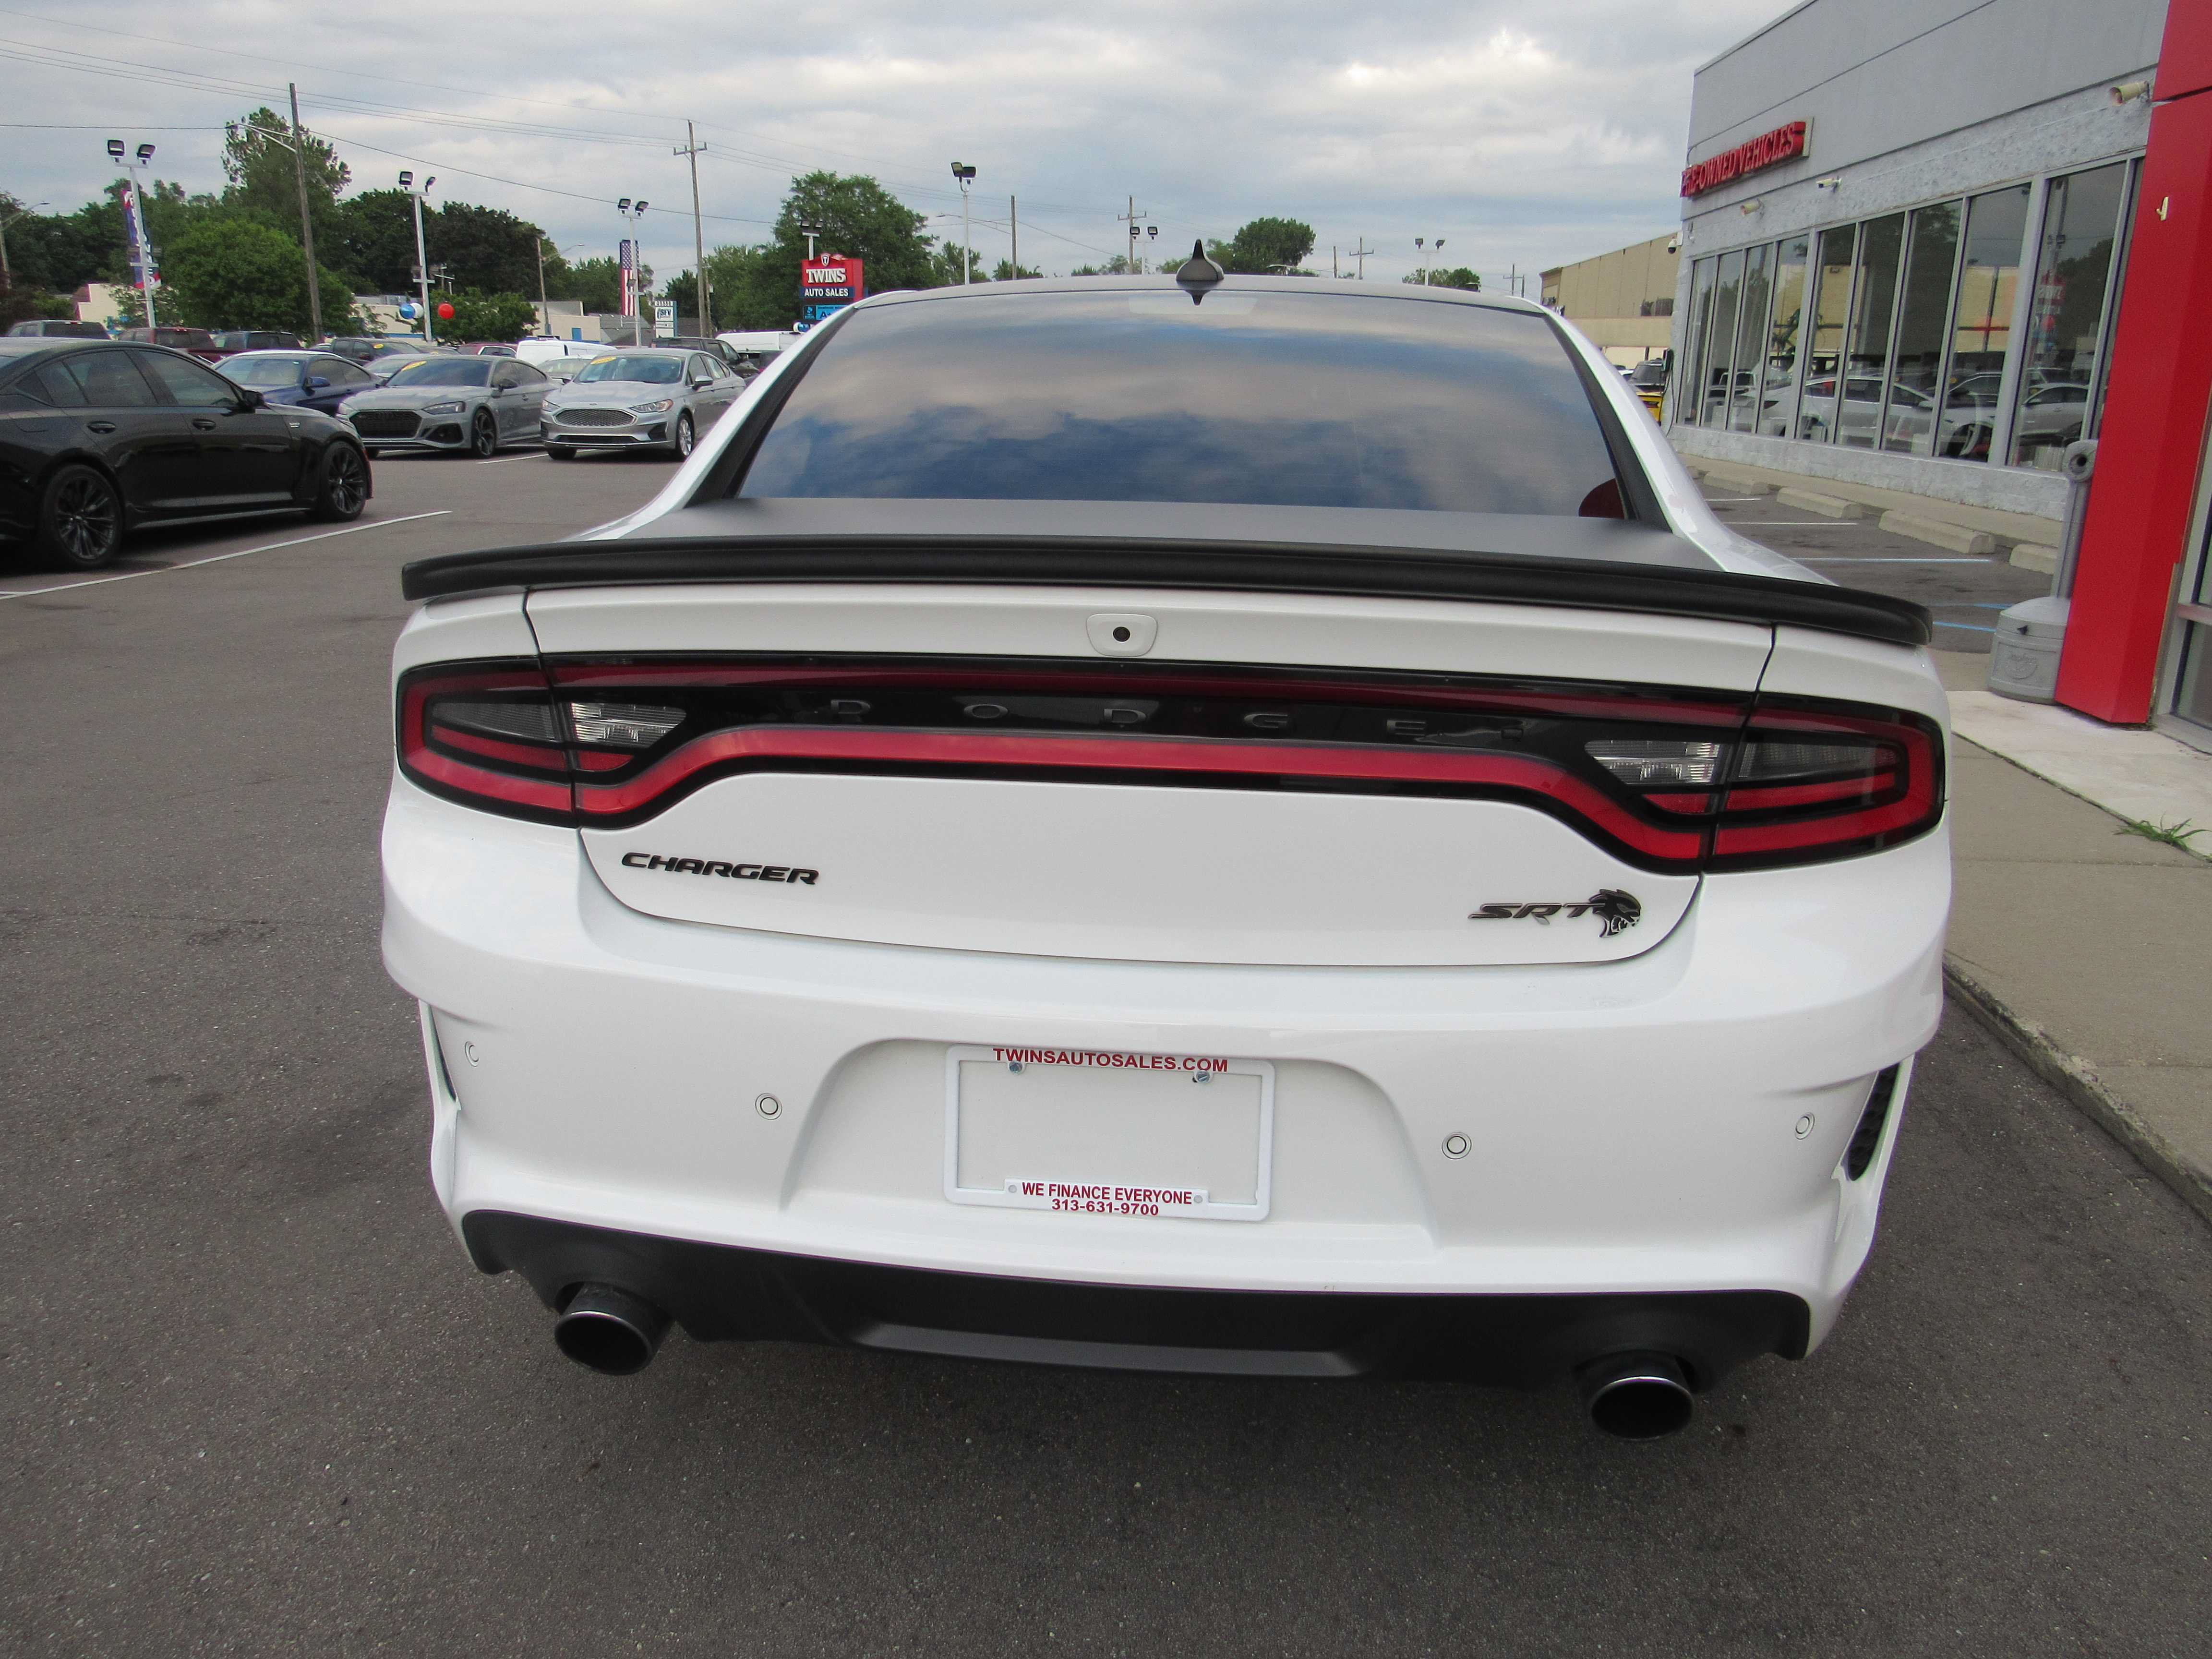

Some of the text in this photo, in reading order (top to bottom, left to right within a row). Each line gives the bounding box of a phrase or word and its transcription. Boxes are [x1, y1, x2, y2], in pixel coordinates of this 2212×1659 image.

[1739, 122, 1800, 173] VEHICLES
[806, 268, 847, 283] TWINS
[805, 288, 849, 297] AUTO SALES
[622, 852, 819, 885] CHARGER
[1467, 902, 1606, 925] SRT
[993, 1048, 1228, 1072] TWINSAUTOSALES.COM
[1022, 1182, 1192, 1204] WE FINANCE EVERYONE
[1051, 1199, 1159, 1216] 313-631-9700
